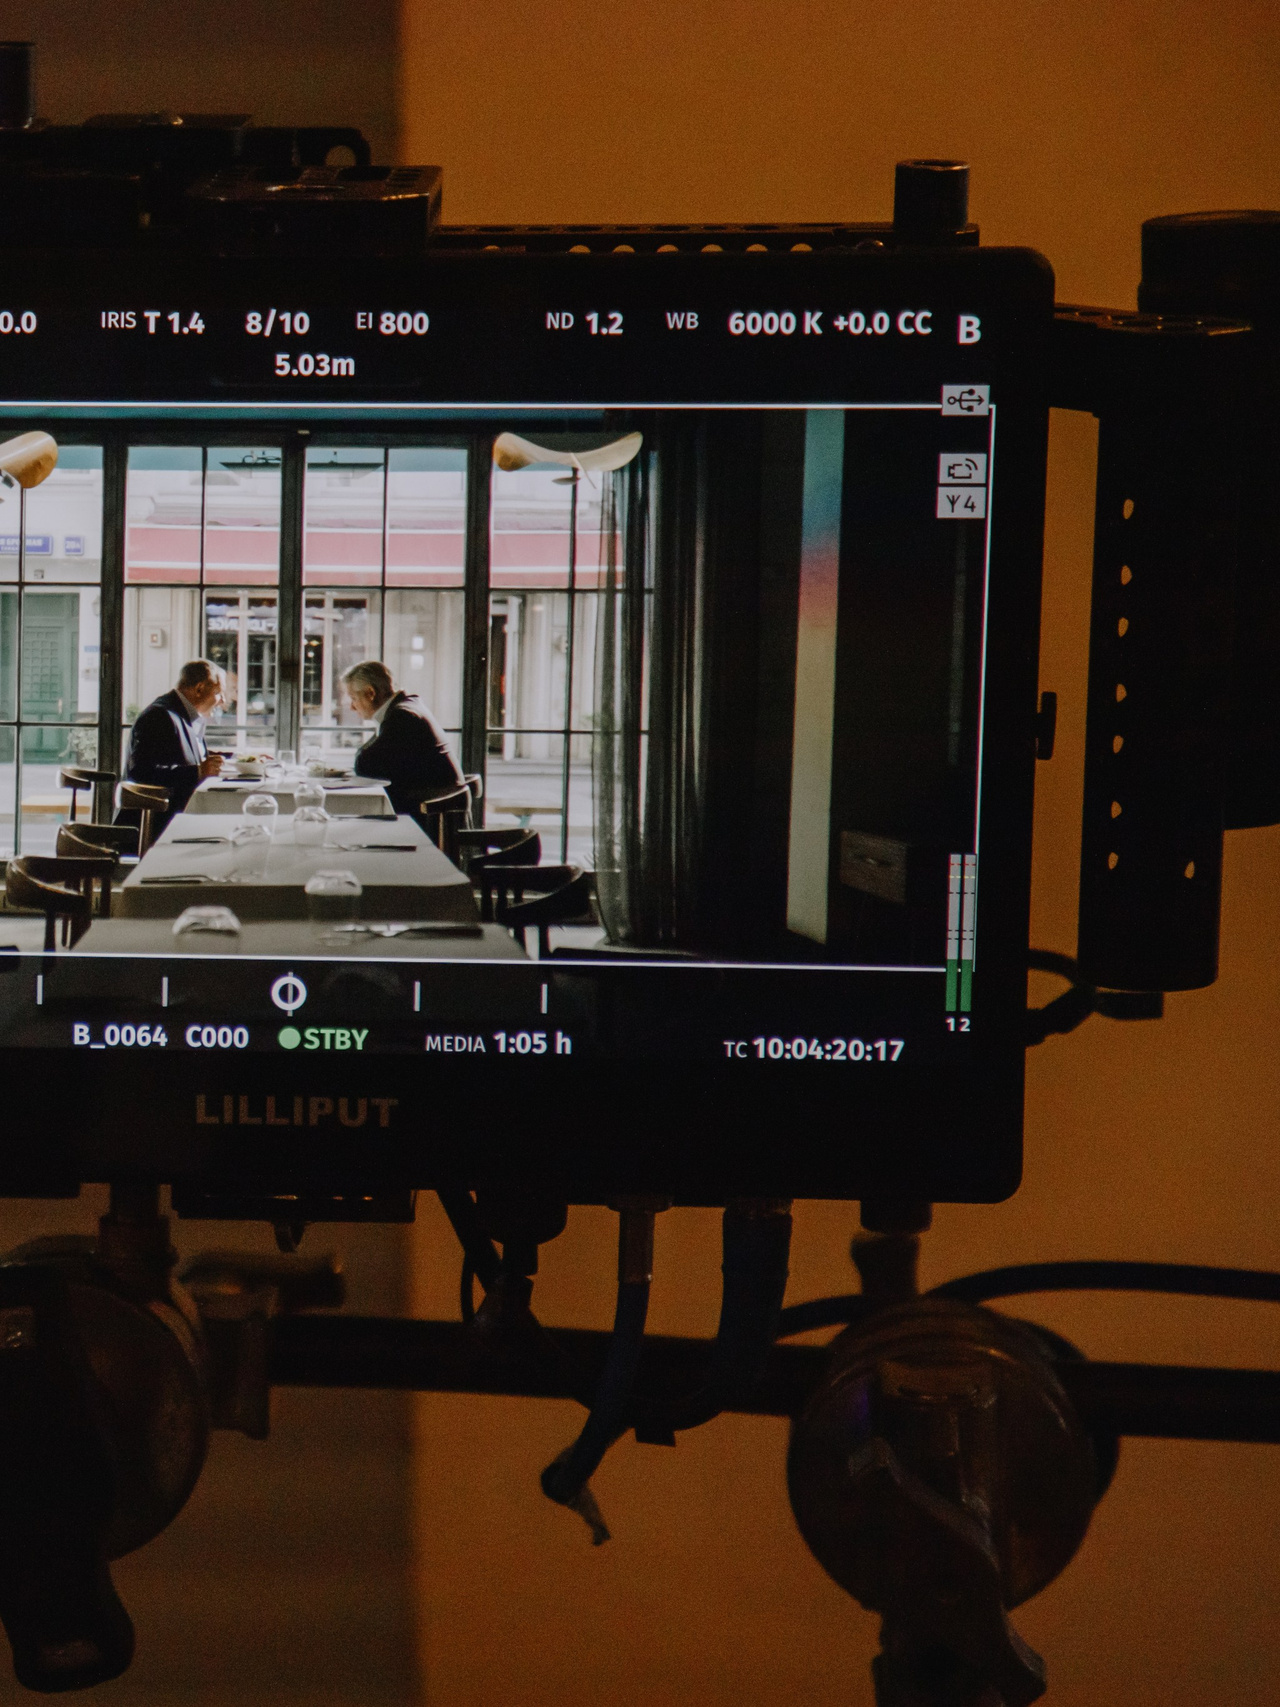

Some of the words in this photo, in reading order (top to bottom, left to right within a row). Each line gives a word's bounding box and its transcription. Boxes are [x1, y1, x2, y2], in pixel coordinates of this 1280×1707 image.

[101, 311, 137, 329] IRIS
[143, 311, 161, 334] T
[167, 311, 206, 334] 1.4
[245, 309, 310, 336] 8/10
[356, 311, 373, 330] EI
[379, 312, 430, 335] 800
[546, 311, 575, 330] ND
[586, 312, 624, 335] 1.2
[666, 311, 699, 330] WB
[729, 312, 797, 335] 6000
[804, 312, 824, 335] K
[833, 312, 890, 335] +0.0
[898, 311, 933, 335] CC
[958, 314, 982, 344] B
[274, 353, 355, 377] 5.03m
[73, 1023, 168, 1049] B_0064
[185, 1025, 249, 1049] C000
[303, 1027, 369, 1051] STBY
[425, 1035, 487, 1053] MEDIA
[493, 1031, 548, 1055] 1:05
[555, 1030, 572, 1055] h
[723, 1040, 748, 1058] TC
[751, 1037, 905, 1062] 10:04:20:17
[195, 1095, 399, 1129] LILLIPUT
